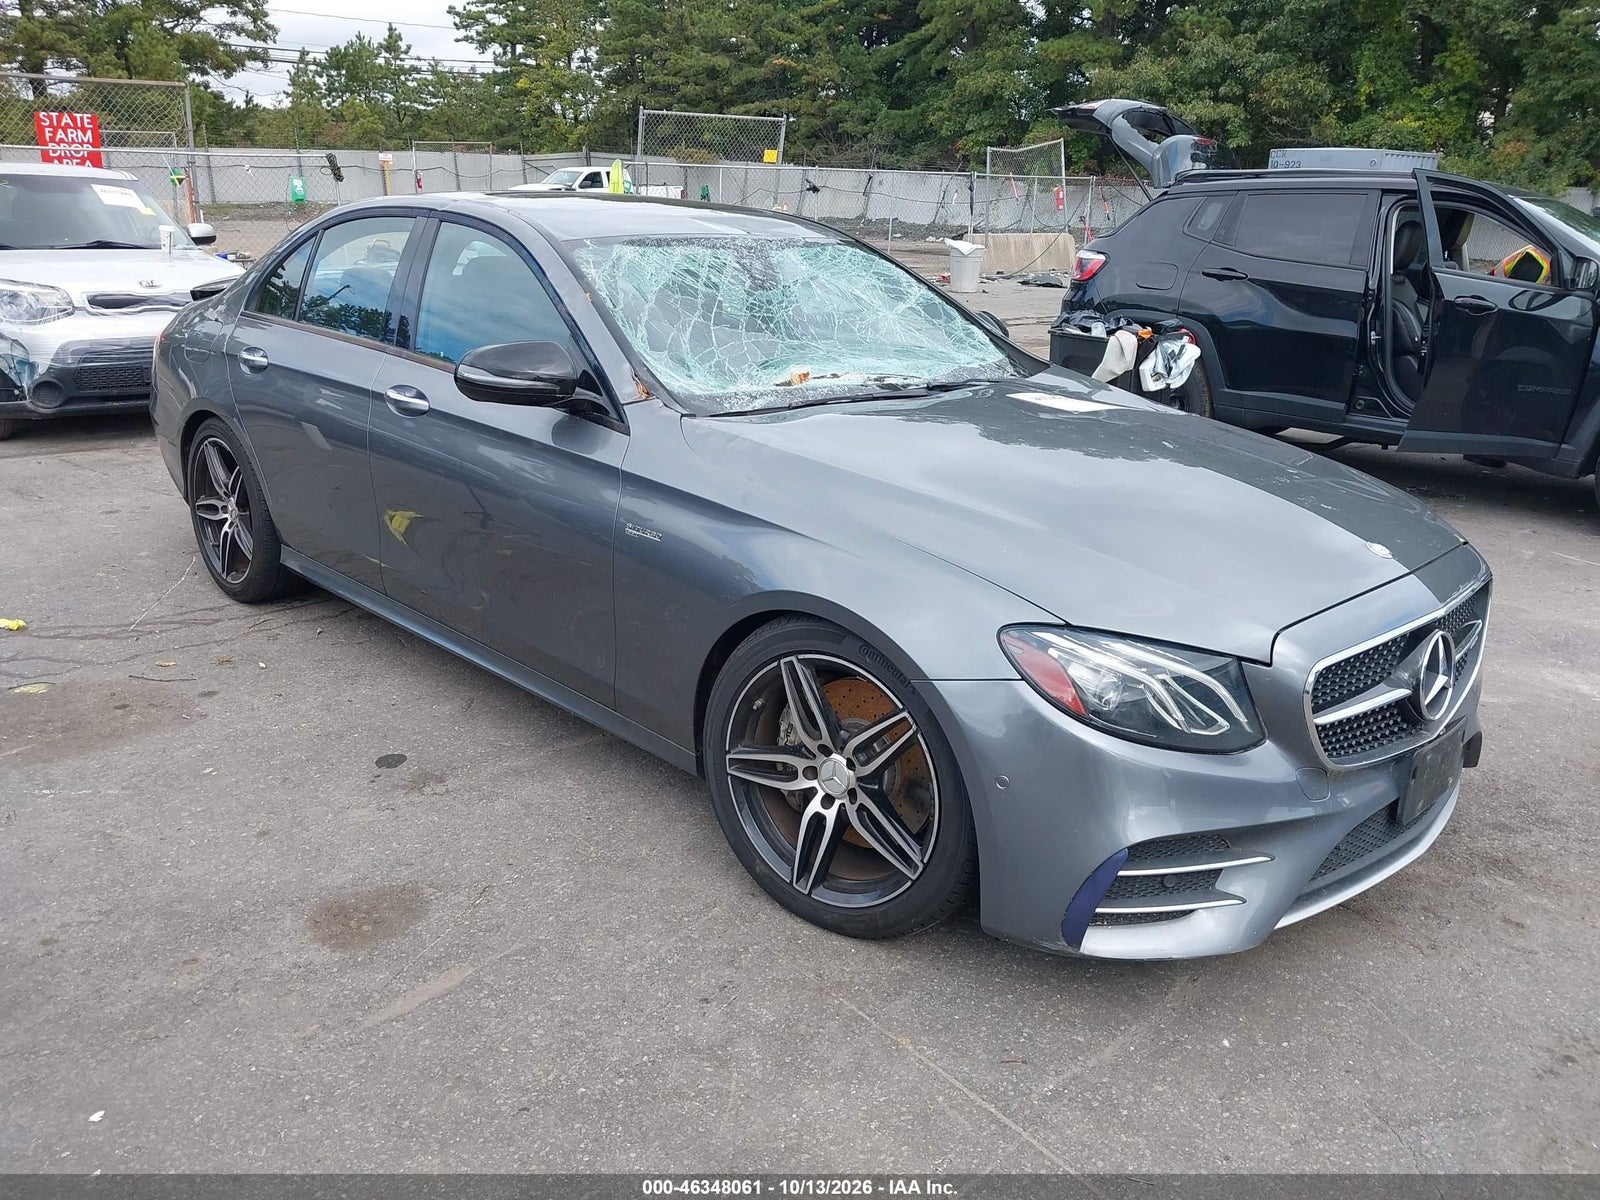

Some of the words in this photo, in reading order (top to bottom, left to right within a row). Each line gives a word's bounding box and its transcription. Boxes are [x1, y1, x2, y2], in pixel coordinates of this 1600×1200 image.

[40, 112, 93, 128] STATE
[45, 128, 93, 143] FARM
[48, 143, 93, 157] DROP
[1271, 160, 1301, 168] 10-923
[859, 644, 910, 688] Continental
